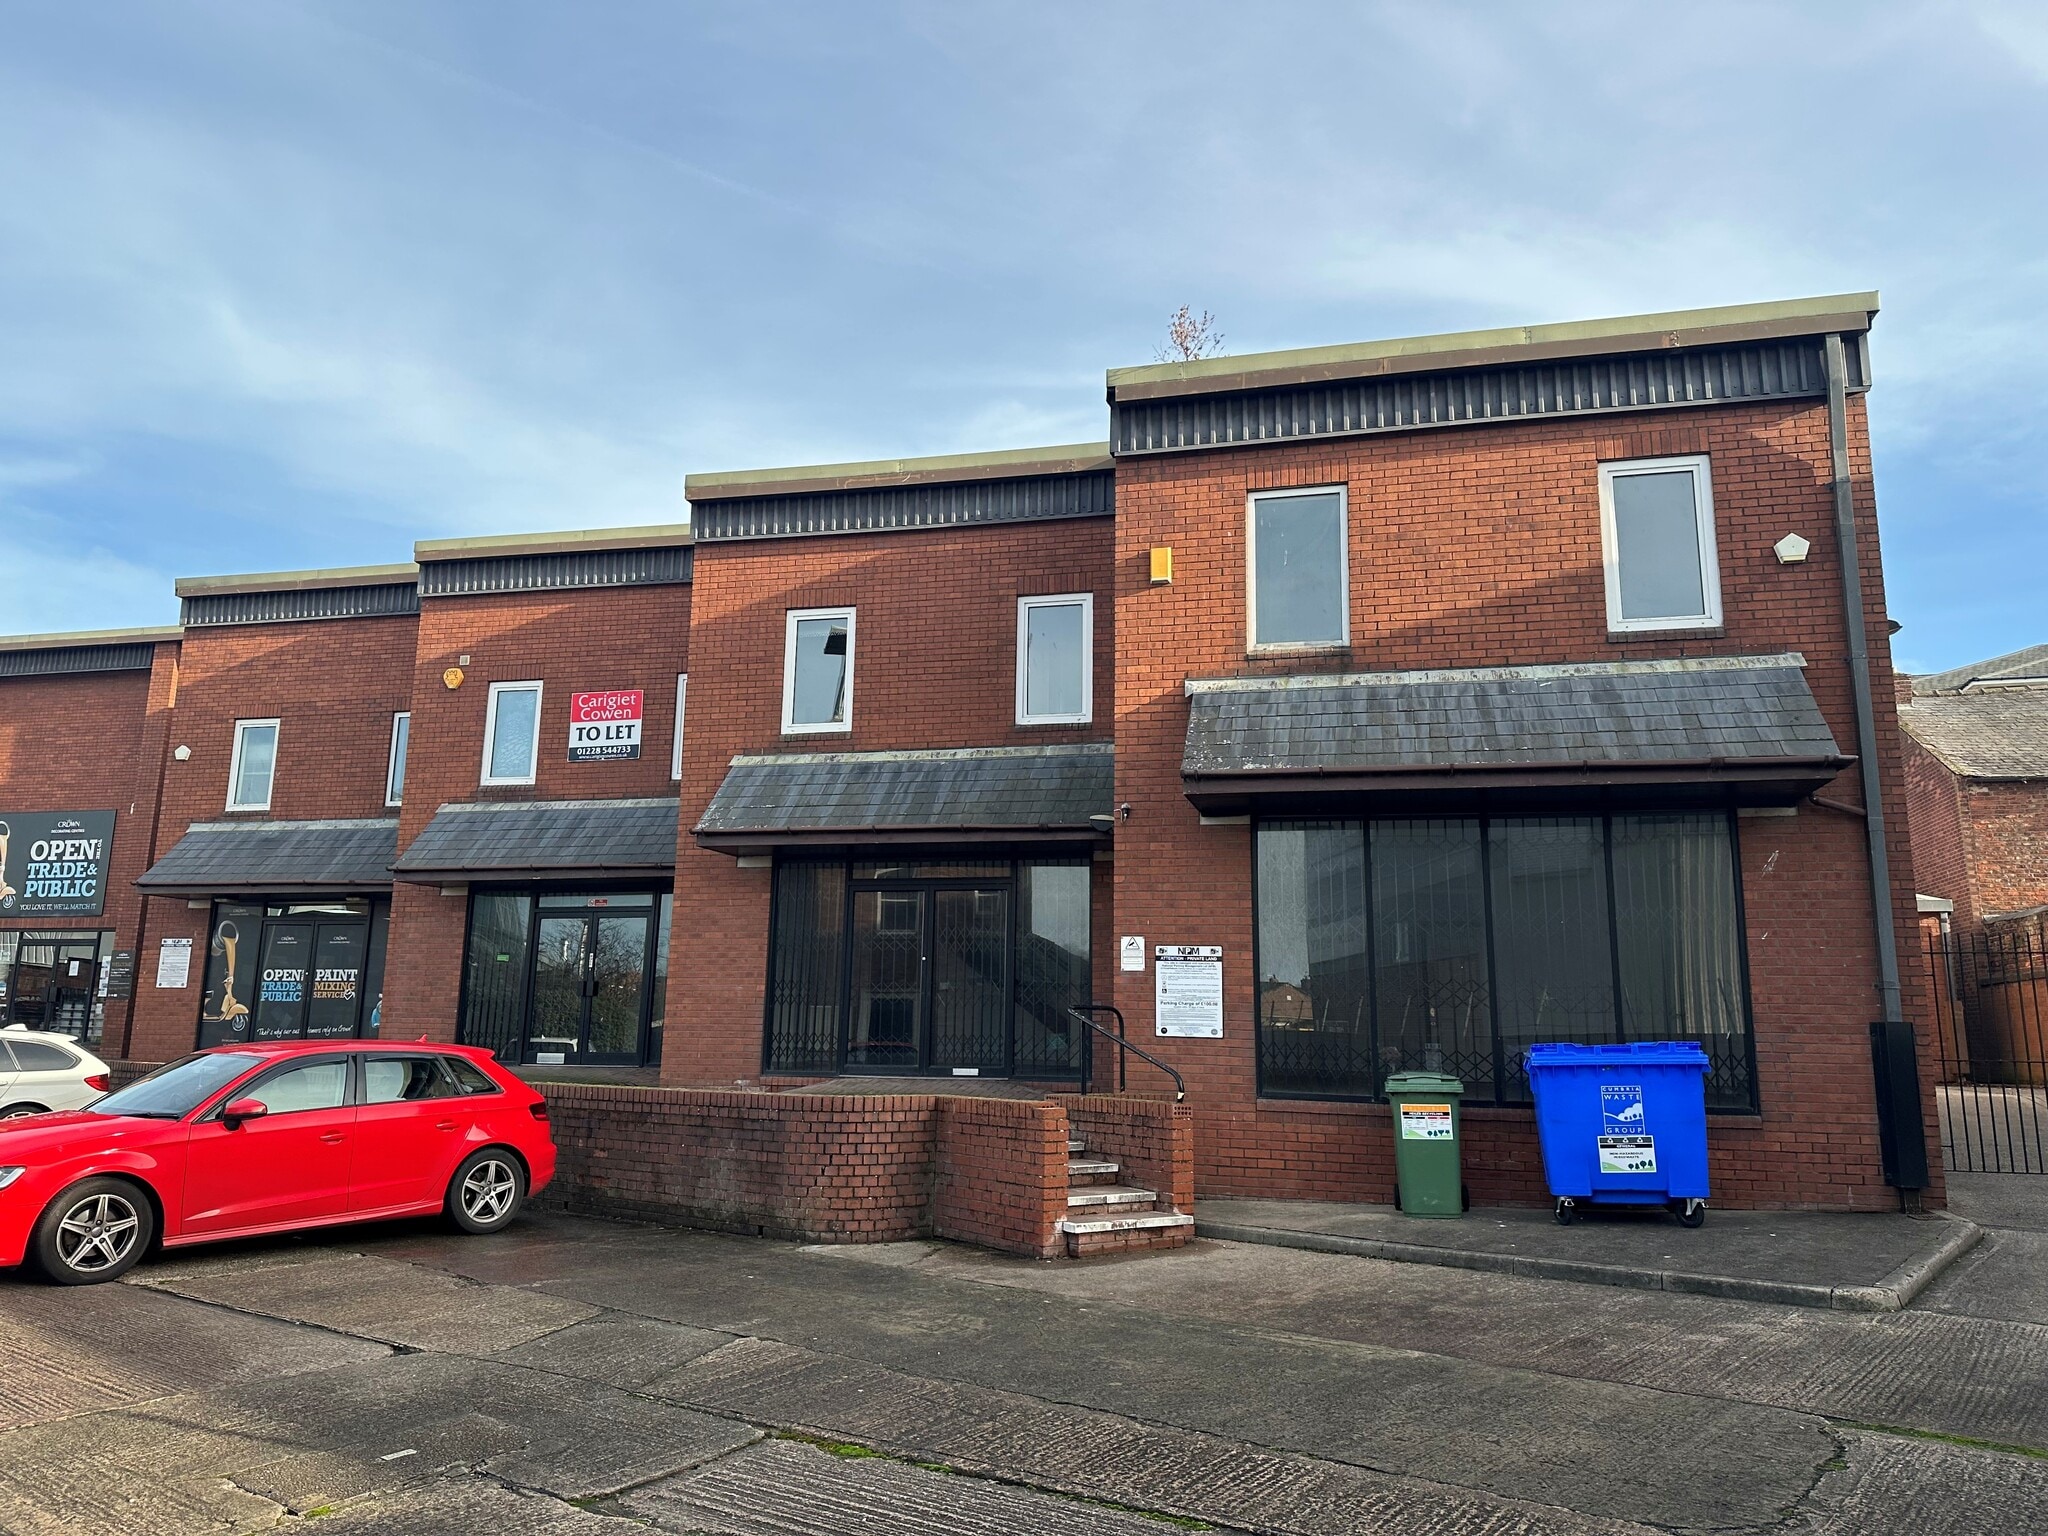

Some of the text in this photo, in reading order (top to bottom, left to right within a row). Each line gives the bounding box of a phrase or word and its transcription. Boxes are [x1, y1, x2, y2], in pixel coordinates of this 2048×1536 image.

[579, 694, 636, 710] Carigiet
[580, 707, 631, 720] Cowen
[576, 724, 636, 742] TO LET
[577, 745, 631, 755] 01228 544733
[57, 819, 81, 828] CROWN
[30, 839, 97, 861] OPEN
[27, 861, 98, 879] TRADE &
[23, 879, 97, 898] PUBLIC
[19, 903, 32, 911] YOU
[31, 903, 46, 911] LOVE
[1178, 947, 1200, 956] NPM
[263, 969, 302, 982] OPEN
[315, 969, 358, 982] PAINT
[261, 981, 297, 991] TRADE
[313, 981, 356, 991] MIXING
[260, 991, 302, 1002] PUBLIC
[312, 991, 345, 999] SERVICE
[273, 1028, 283, 1039] why
[322, 1025, 332, 1037] rely
